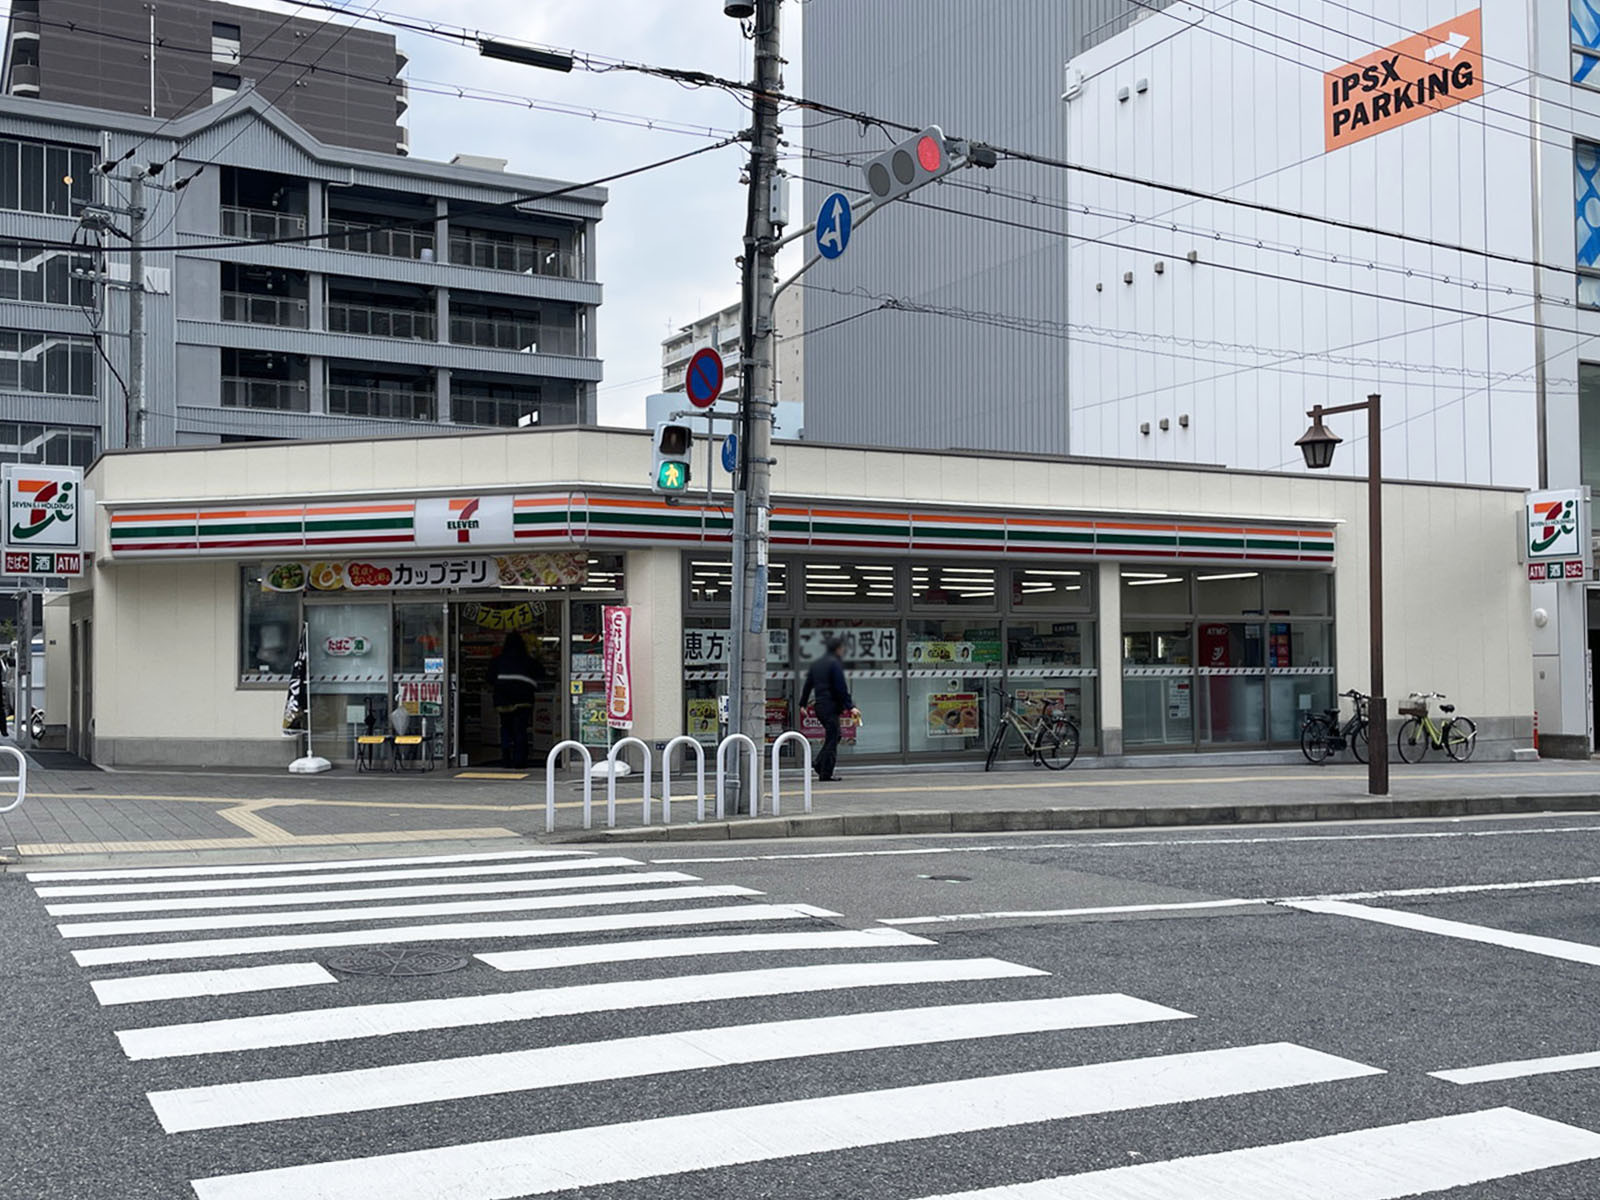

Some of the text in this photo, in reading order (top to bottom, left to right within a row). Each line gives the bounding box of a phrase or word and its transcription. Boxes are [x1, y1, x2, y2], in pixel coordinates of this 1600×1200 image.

[1332, 55, 1400, 106] IPSX
[1333, 61, 1473, 137] PARKING
[57, 556, 79, 571] ATM
[394, 560, 487, 585] カップデリ
[1529, 565, 1545, 577] ATM
[328, 639, 350, 651] たばこ
